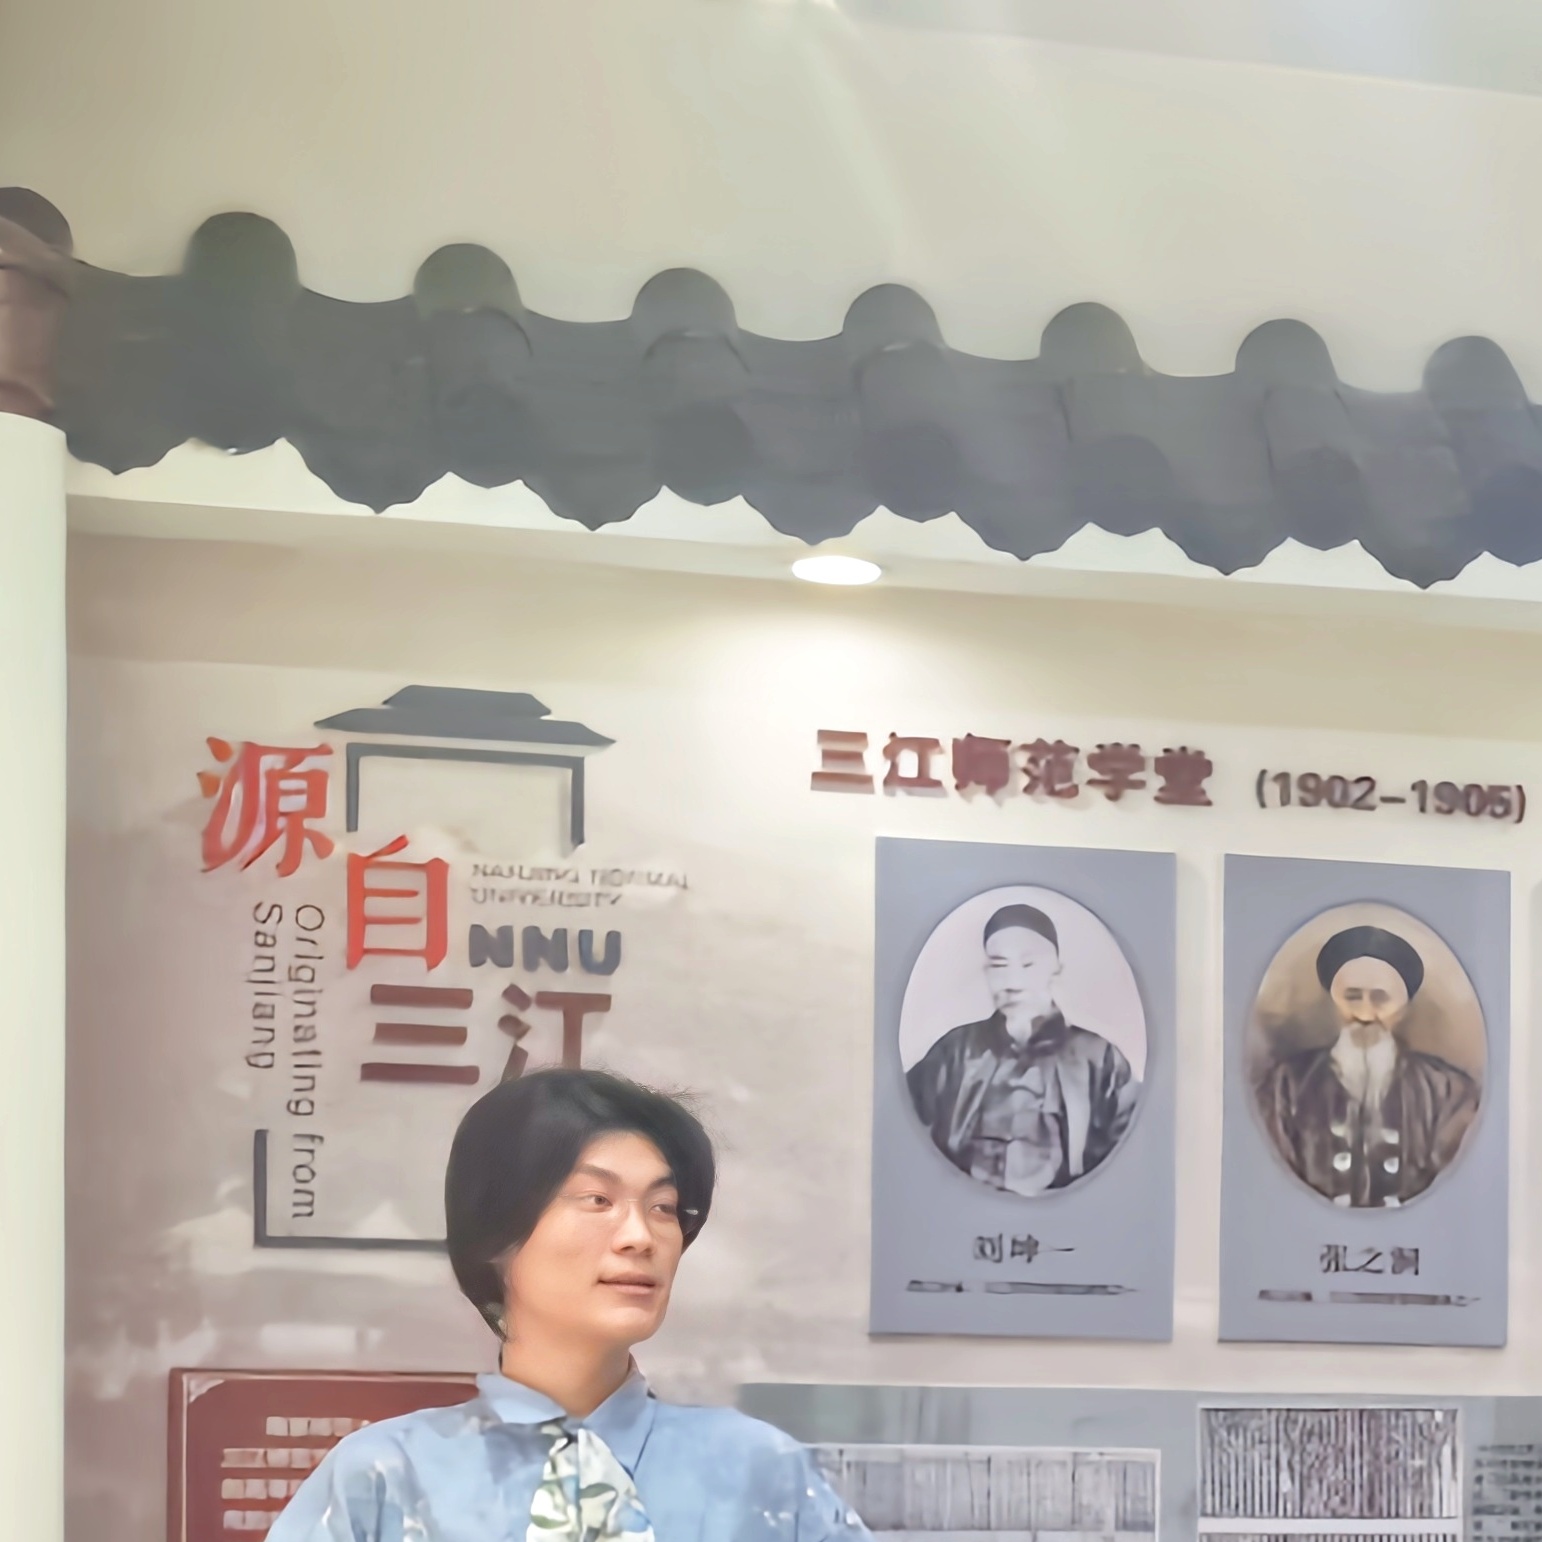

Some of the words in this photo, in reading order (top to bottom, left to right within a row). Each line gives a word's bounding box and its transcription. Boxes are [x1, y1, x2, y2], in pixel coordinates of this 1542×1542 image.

[810, 729, 1213, 807] 三江师范学堂
[244, 901, 284, 1071] Sanjiang
[468, 923, 622, 976] NNU
[360, 983, 612, 1084] 三江
[291, 1133, 325, 1220] from
